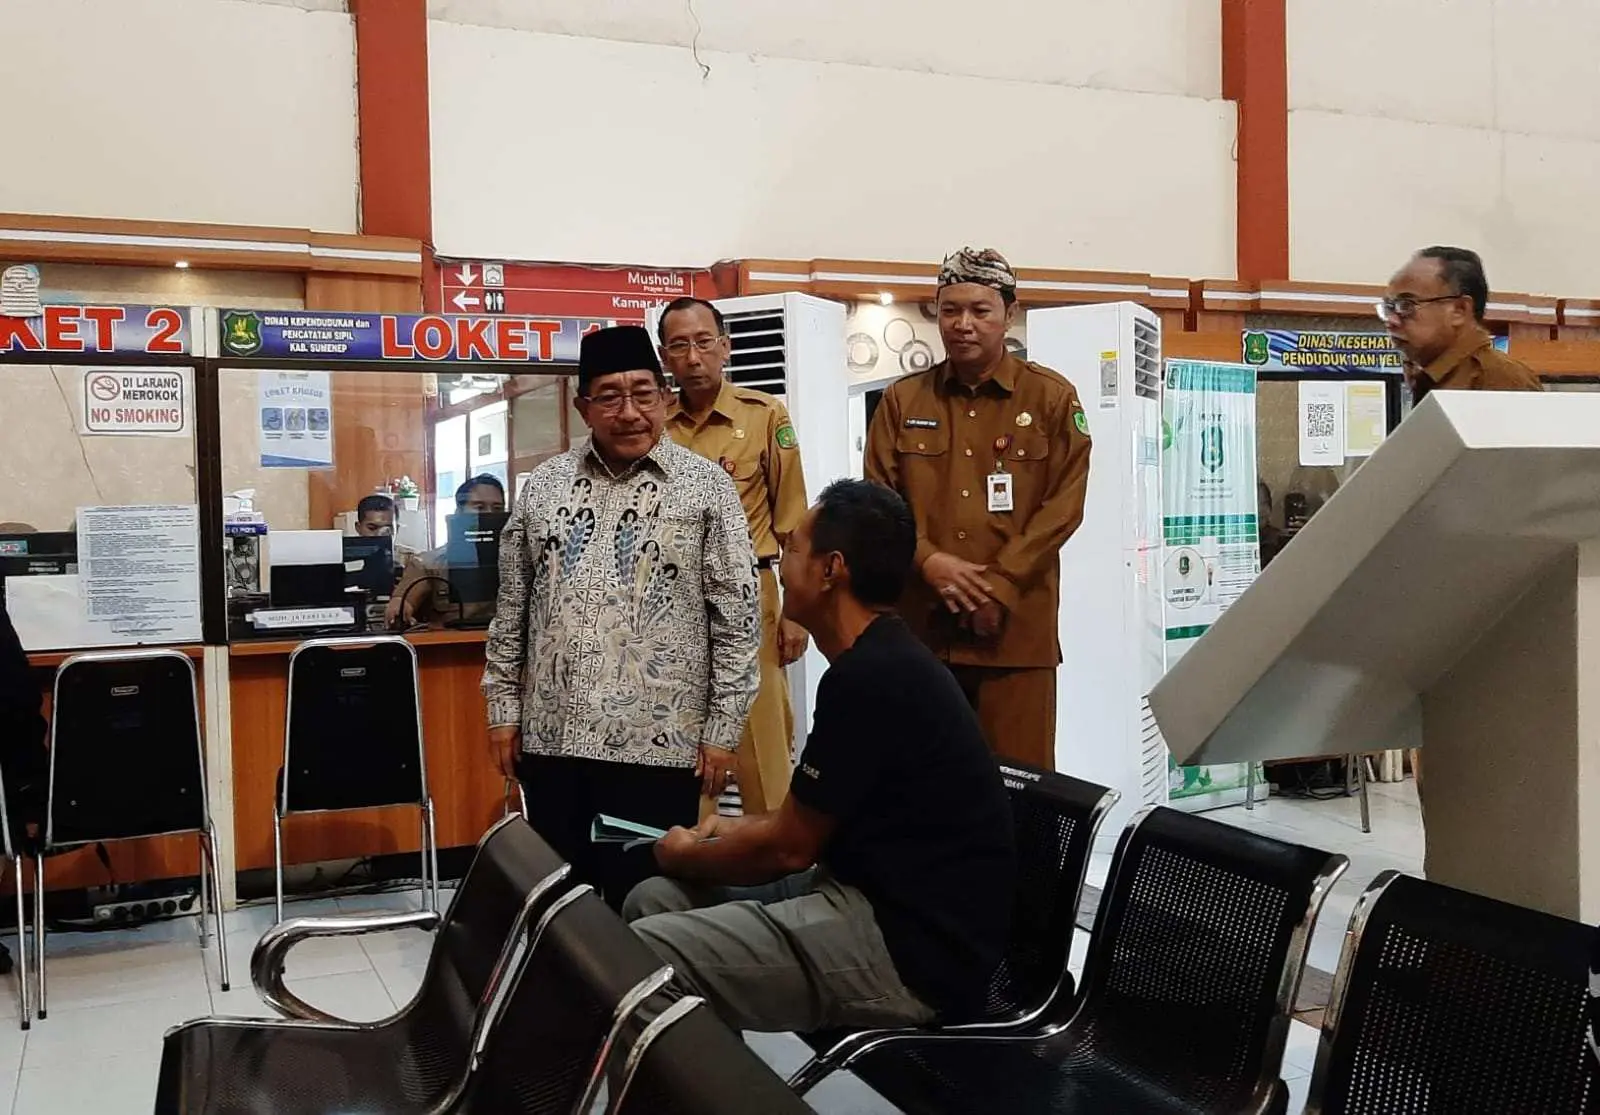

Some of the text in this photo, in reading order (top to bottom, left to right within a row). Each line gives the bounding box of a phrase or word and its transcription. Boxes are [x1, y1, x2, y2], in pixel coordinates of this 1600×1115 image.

[627, 271, 684, 286] Musholla
[612, 296, 653, 309] Kamar
[264, 316, 370, 329] DINAS KEPENDUDUKAN dan
[144, 307, 184, 354] 2
[282, 330, 354, 341] PENCATATAN SIPIL
[380, 315, 563, 361] LOKET
[1298, 334, 1334, 349] DINAS
[289, 343, 348, 353] KAB. SUMENEP
[1282, 351, 1349, 366] PENDUDUK
[1351, 353, 1379, 366] DAN
[122, 377, 178, 389] DI LARANG
[122, 390, 178, 401] MEROKOK
[91, 407, 179, 423] NO SMOKING
